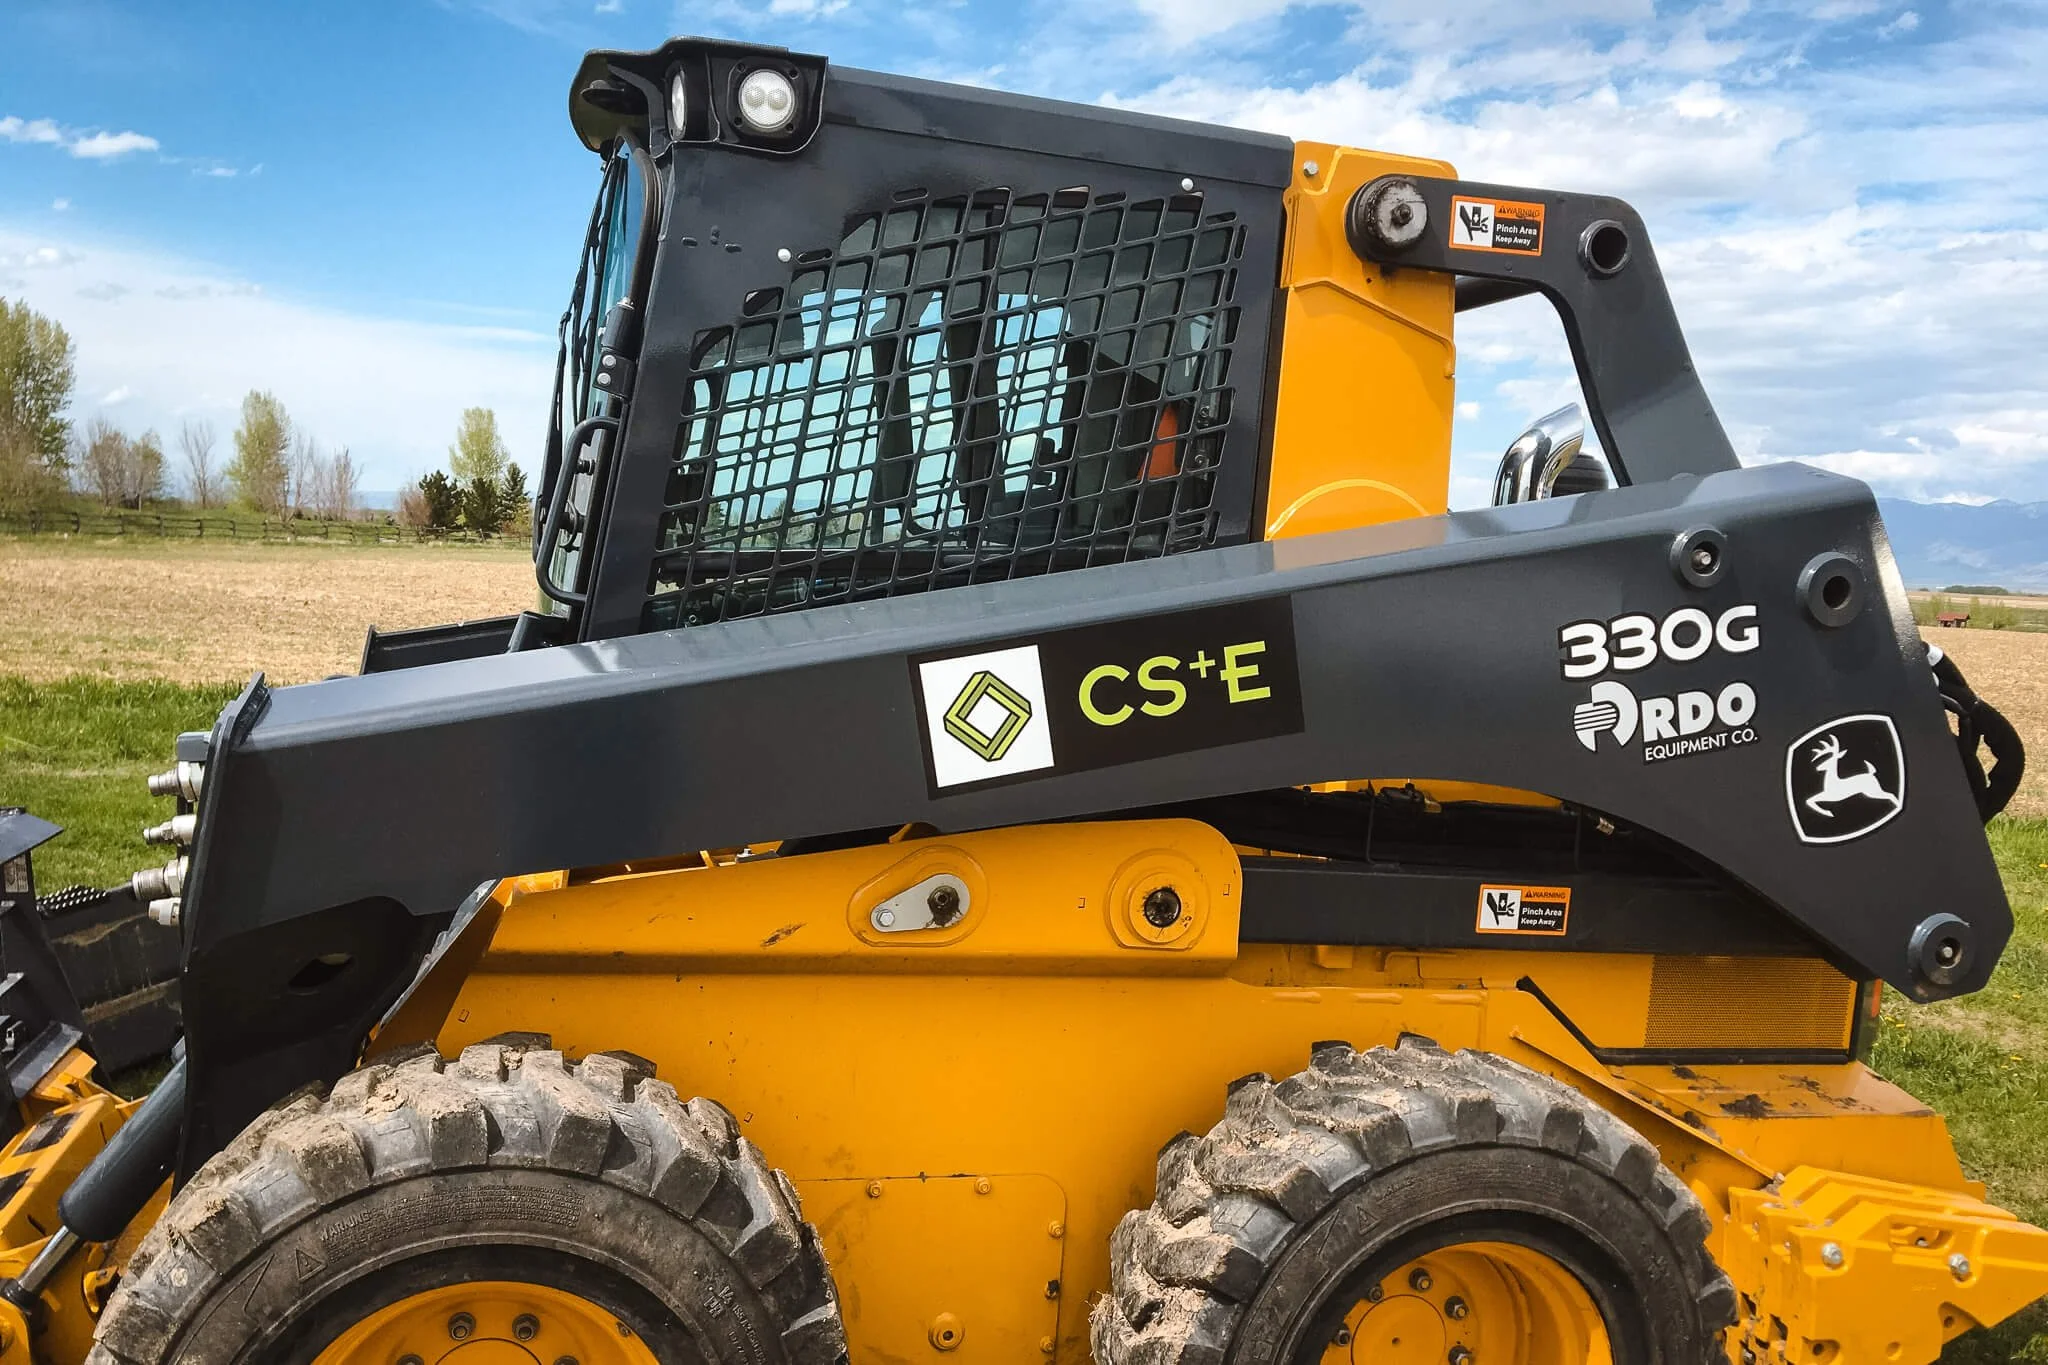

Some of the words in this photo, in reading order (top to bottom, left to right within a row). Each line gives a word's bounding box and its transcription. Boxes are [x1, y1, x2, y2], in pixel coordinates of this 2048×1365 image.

[1506, 206, 1540, 217] WARNING
[1496, 223, 1518, 234] Pinch
[1519, 226, 1537, 236] Area
[1495, 234, 1512, 244] Keep
[1512, 237, 1531, 246] Away
[1562, 604, 1760, 678] 330G
[1645, 733, 1728, 761] EQUIPMENT
[1731, 728, 1758, 744] CO.
[1532, 891, 1566, 899] WARNING
[1522, 907, 1543, 916] Pinch
[1544, 908, 1562, 916] Area
[1521, 918, 1537, 927] Keep
[1538, 918, 1556, 927] Away
